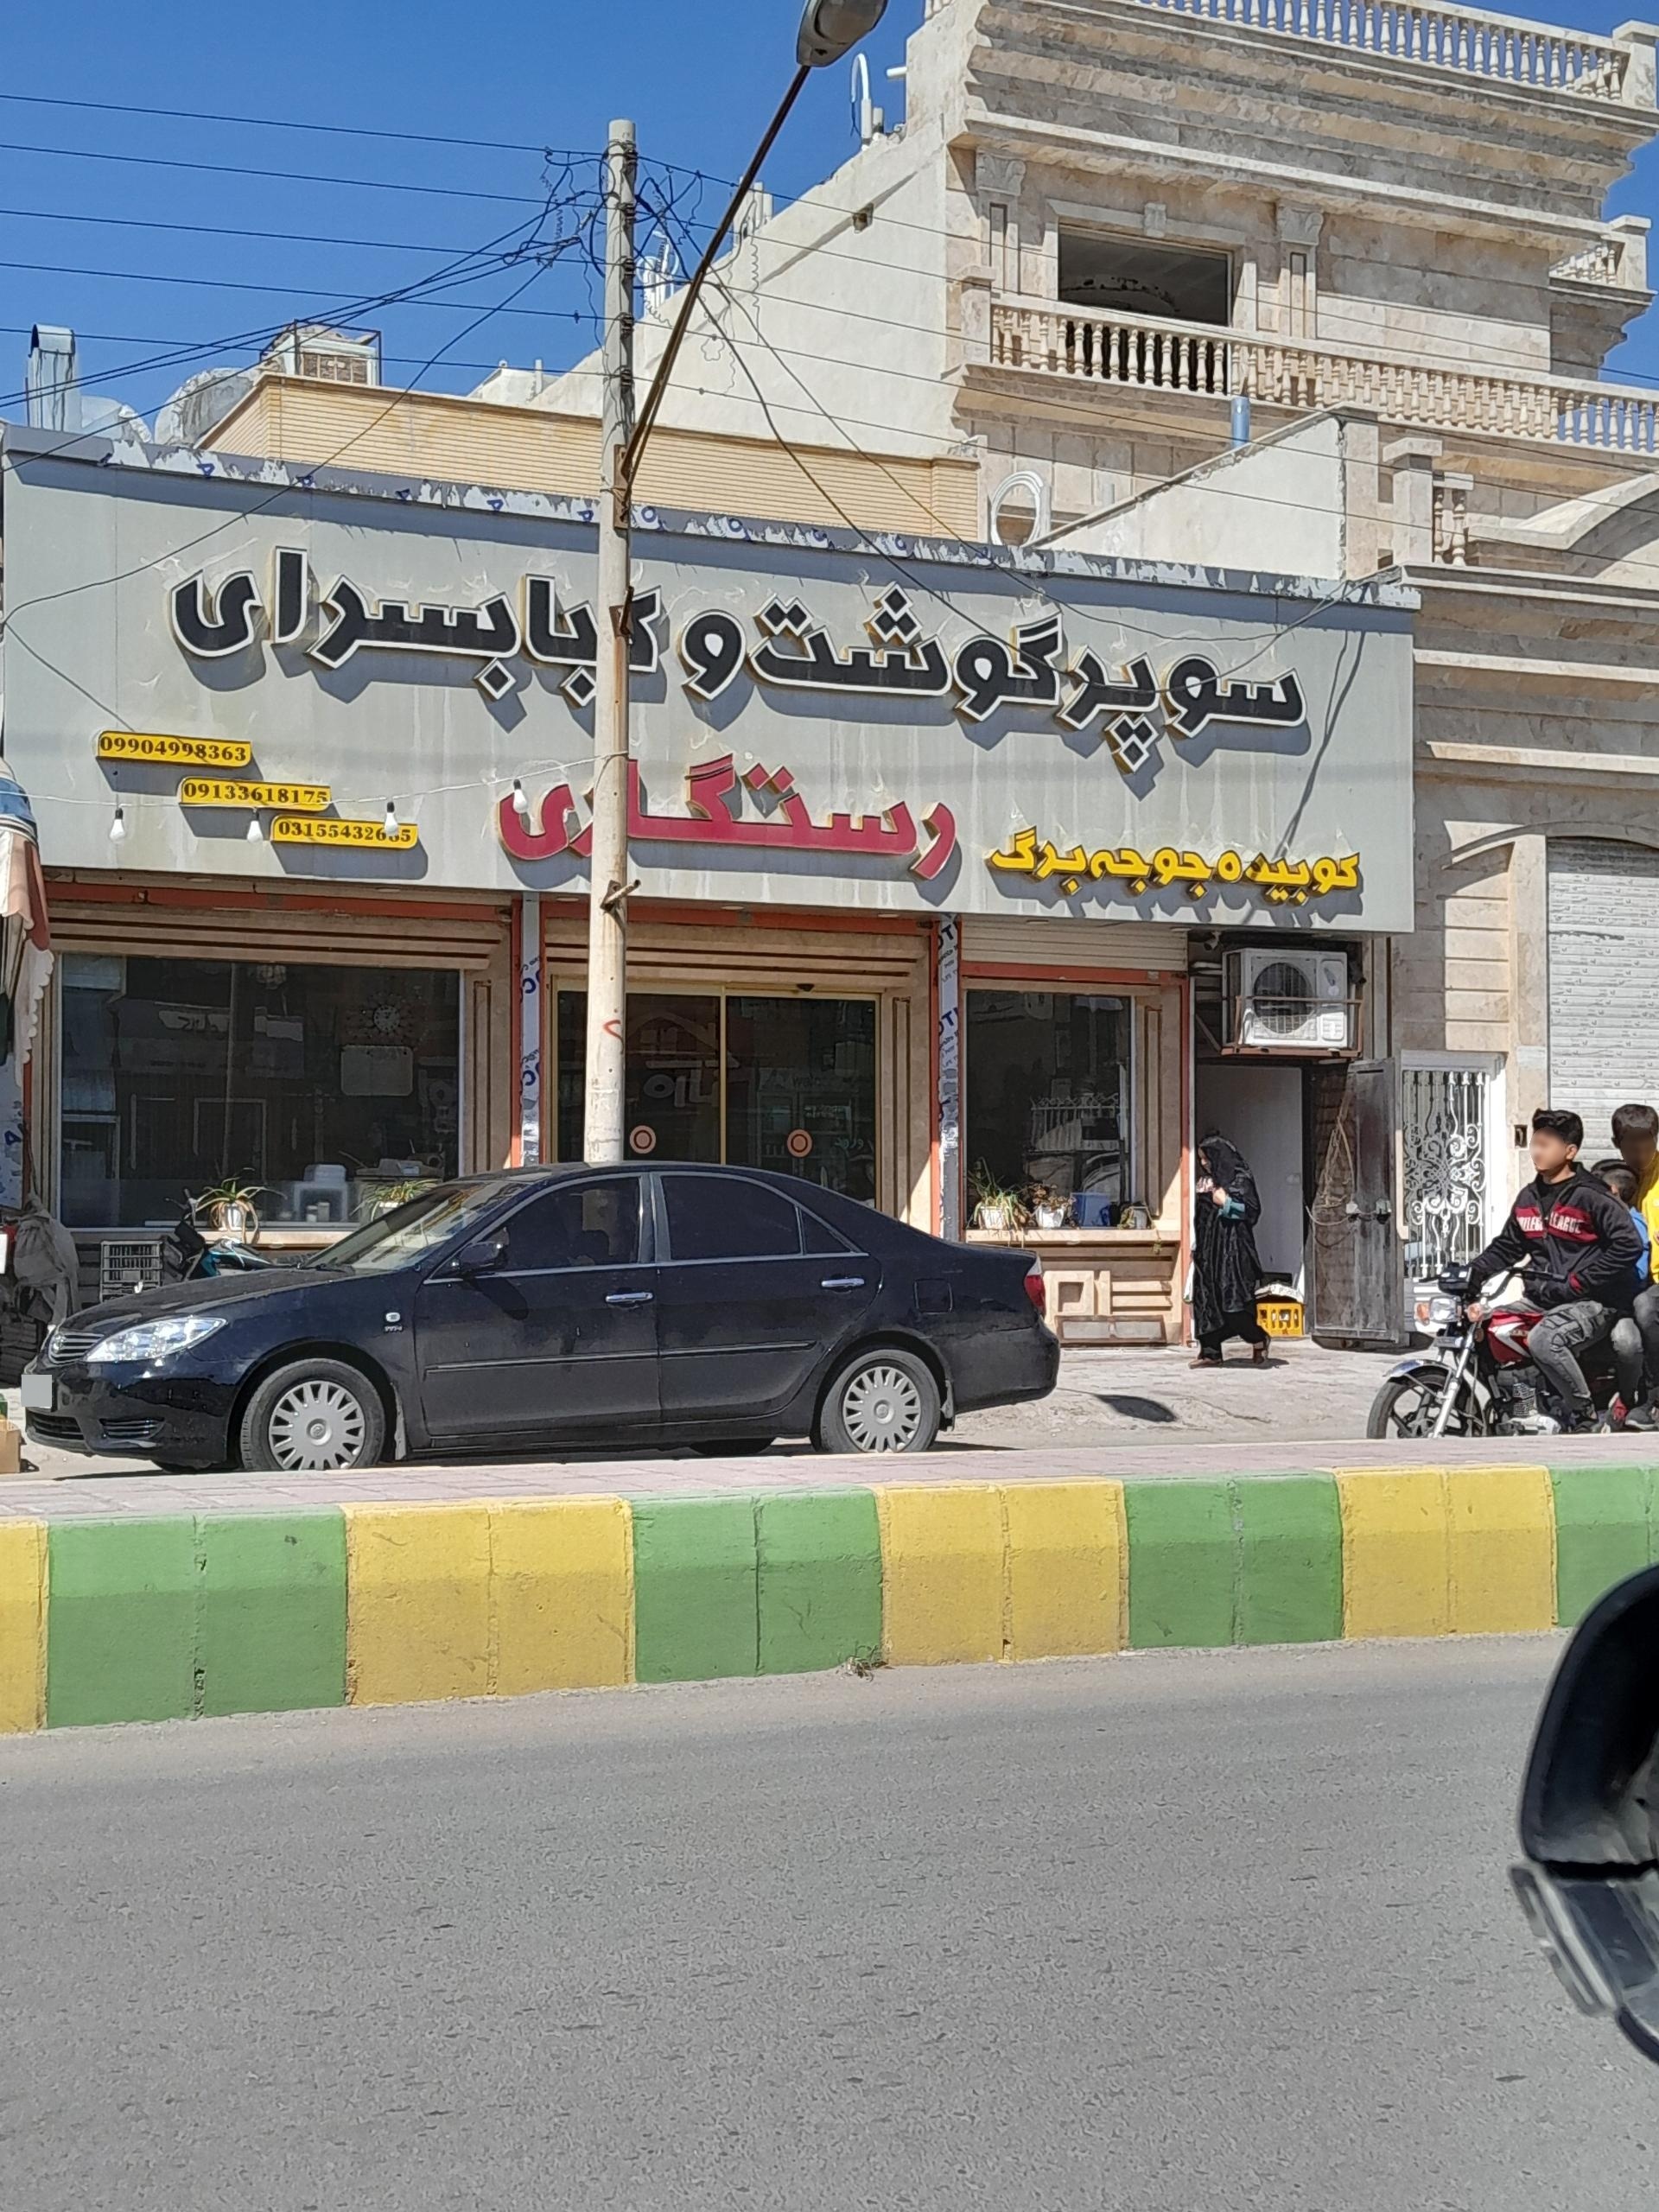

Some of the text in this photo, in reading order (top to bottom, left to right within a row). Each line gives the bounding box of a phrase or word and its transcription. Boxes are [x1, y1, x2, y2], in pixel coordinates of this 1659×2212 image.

[681, 610, 746, 700] و
[750, 584, 1063, 721] گوشت
[99, 735, 246, 761] 09904998363
[1058, 646, 1307, 772] سوپر
[183, 780, 327, 804] 09133618175
[990, 825, 1360, 906] کوبیده جوجه برگ
